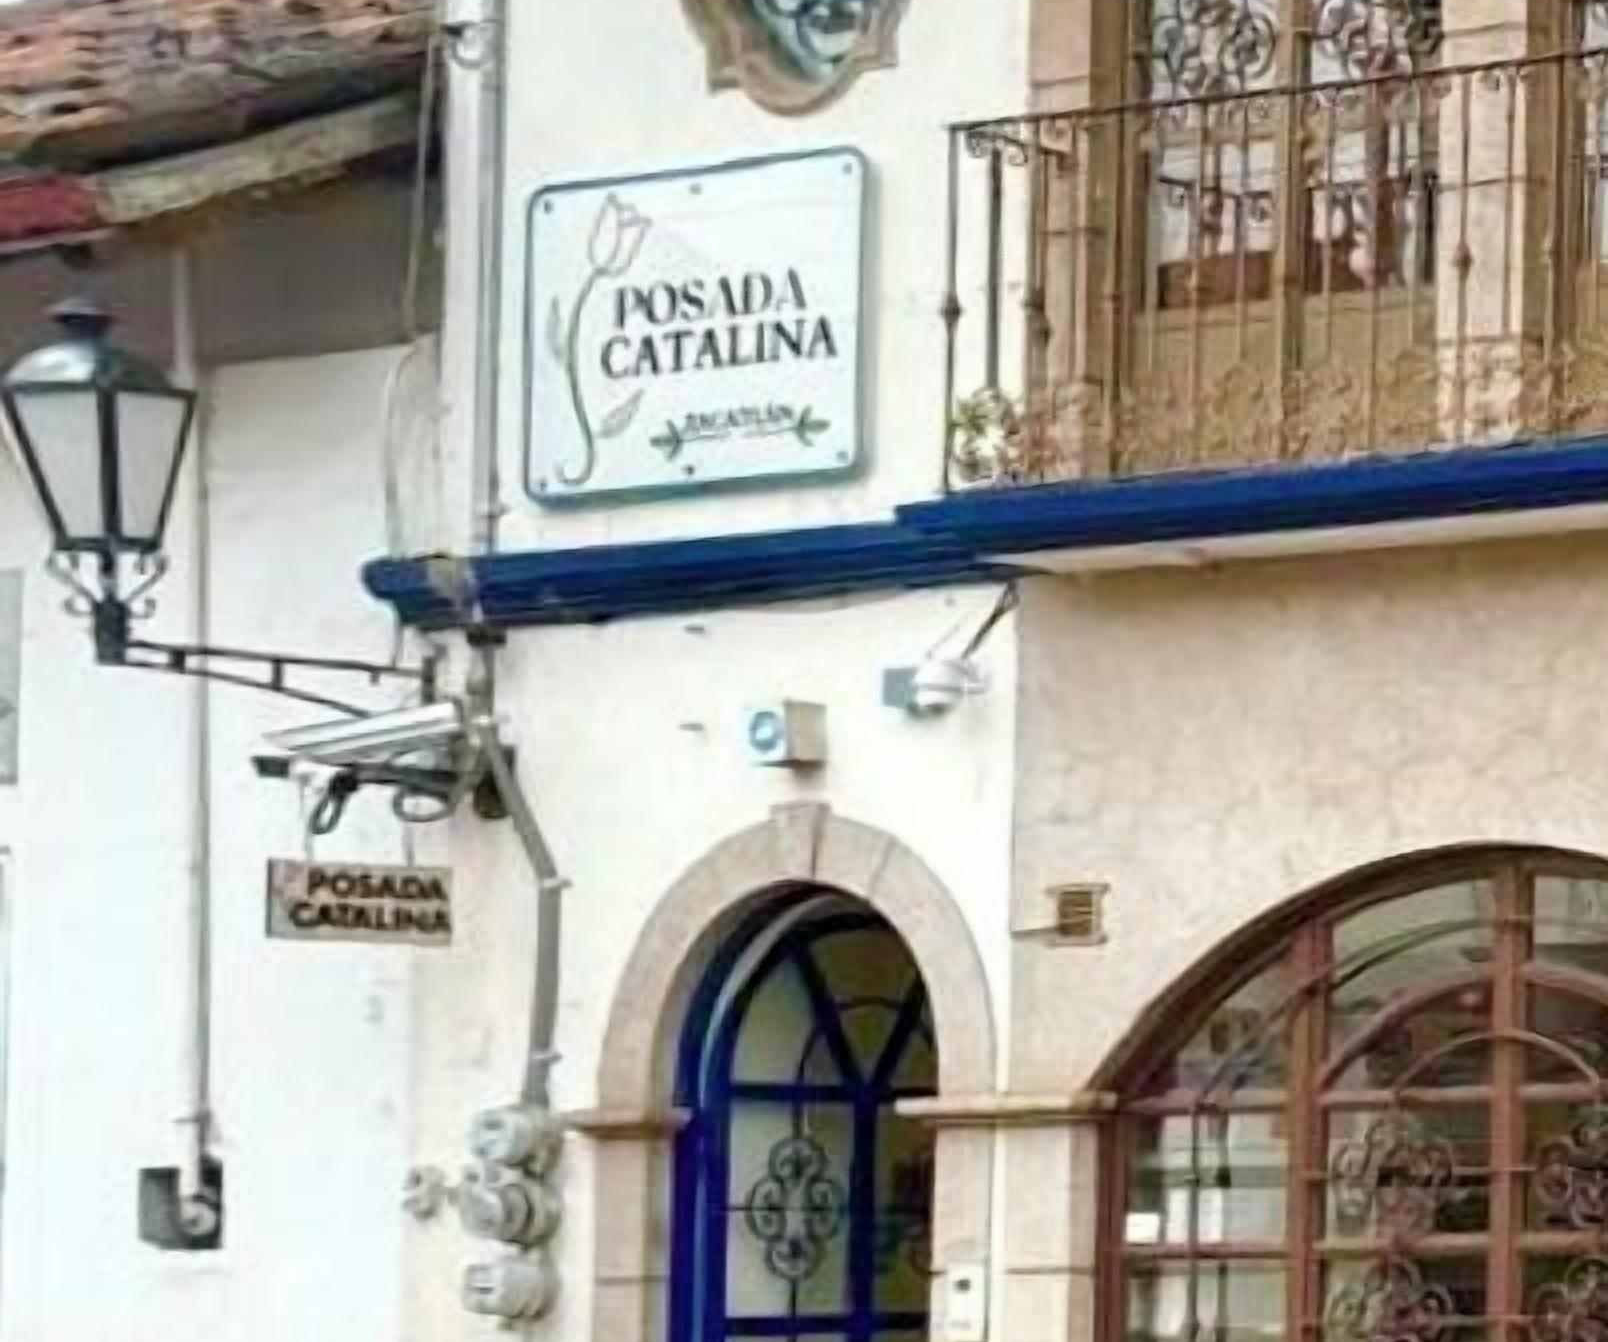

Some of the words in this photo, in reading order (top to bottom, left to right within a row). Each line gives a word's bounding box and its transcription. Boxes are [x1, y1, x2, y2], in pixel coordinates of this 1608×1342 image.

[613, 267, 808, 328] POSADA
[600, 315, 838, 379] CATALINA
[307, 866, 449, 901] POSADA
[290, 901, 451, 934] CATALINA
